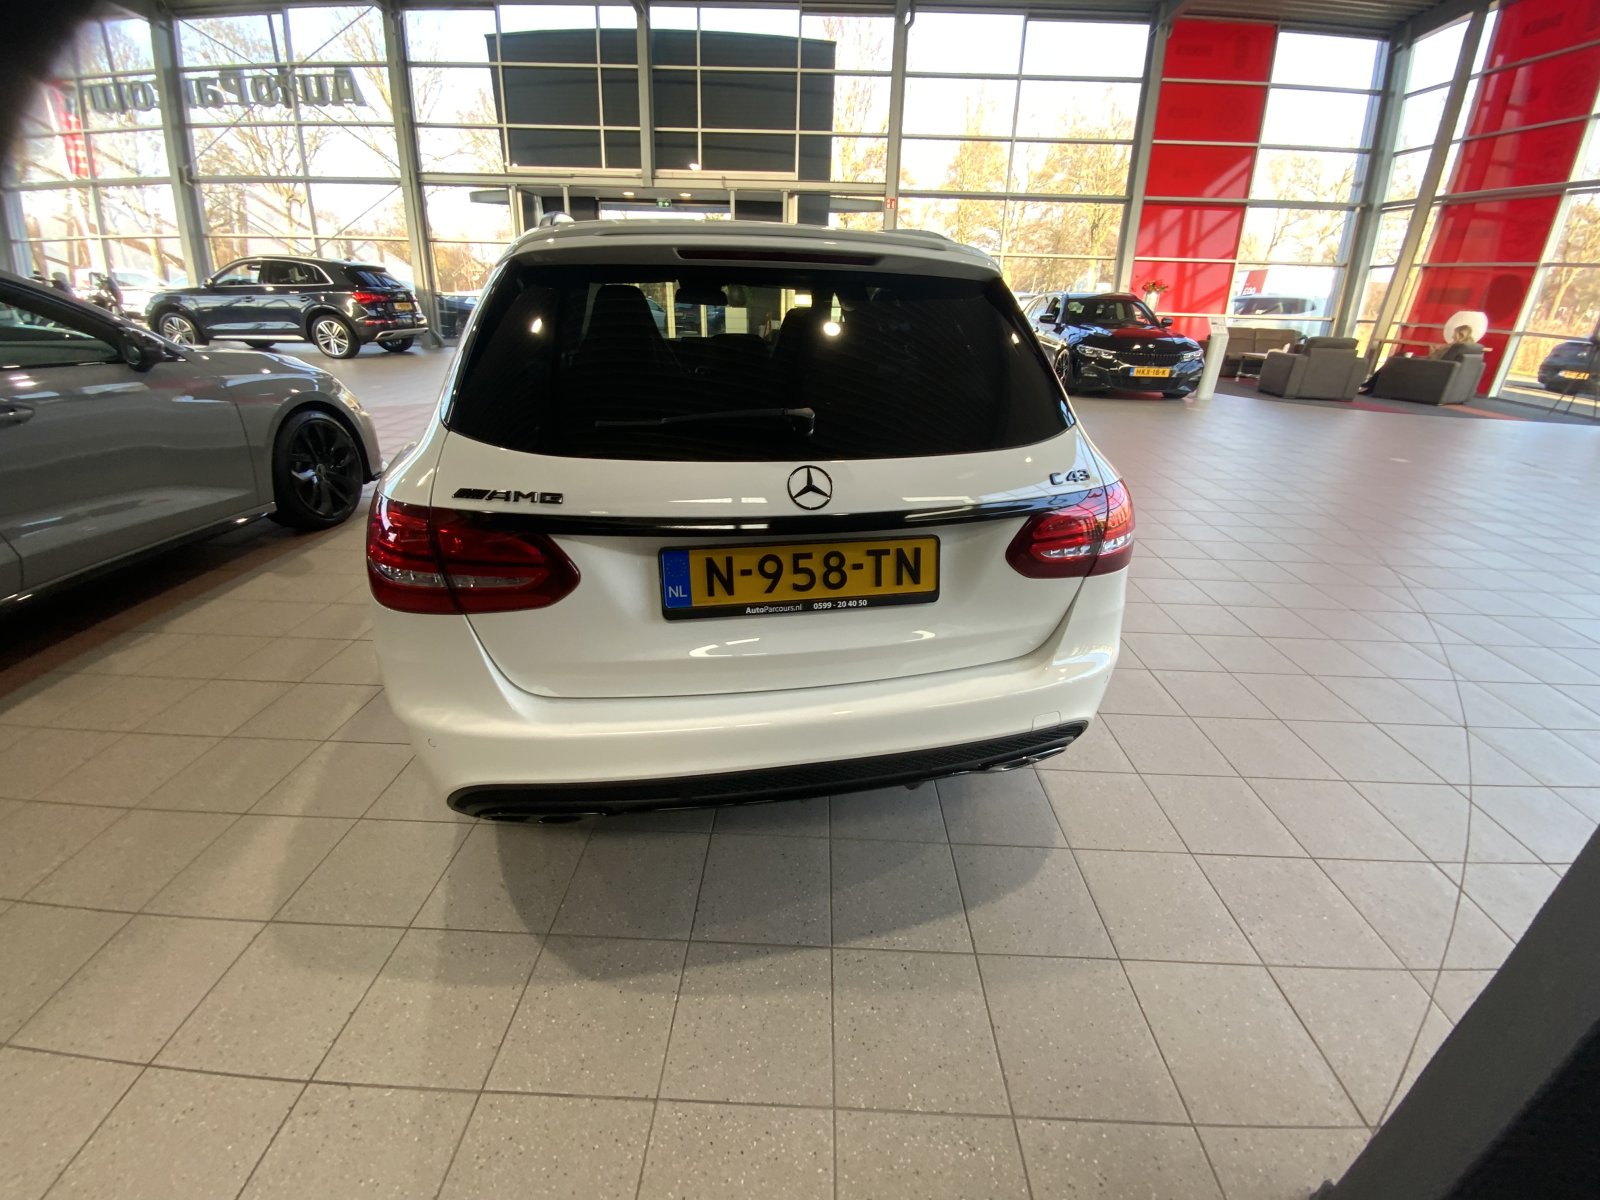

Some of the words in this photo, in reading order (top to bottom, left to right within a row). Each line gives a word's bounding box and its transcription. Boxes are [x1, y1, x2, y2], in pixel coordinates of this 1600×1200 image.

[485, 489, 563, 504] AMG
[705, 547, 922, 597] N-958-TN
[668, 585, 688, 598] NL
[745, 604, 803, 614] AutoParcours.nl
